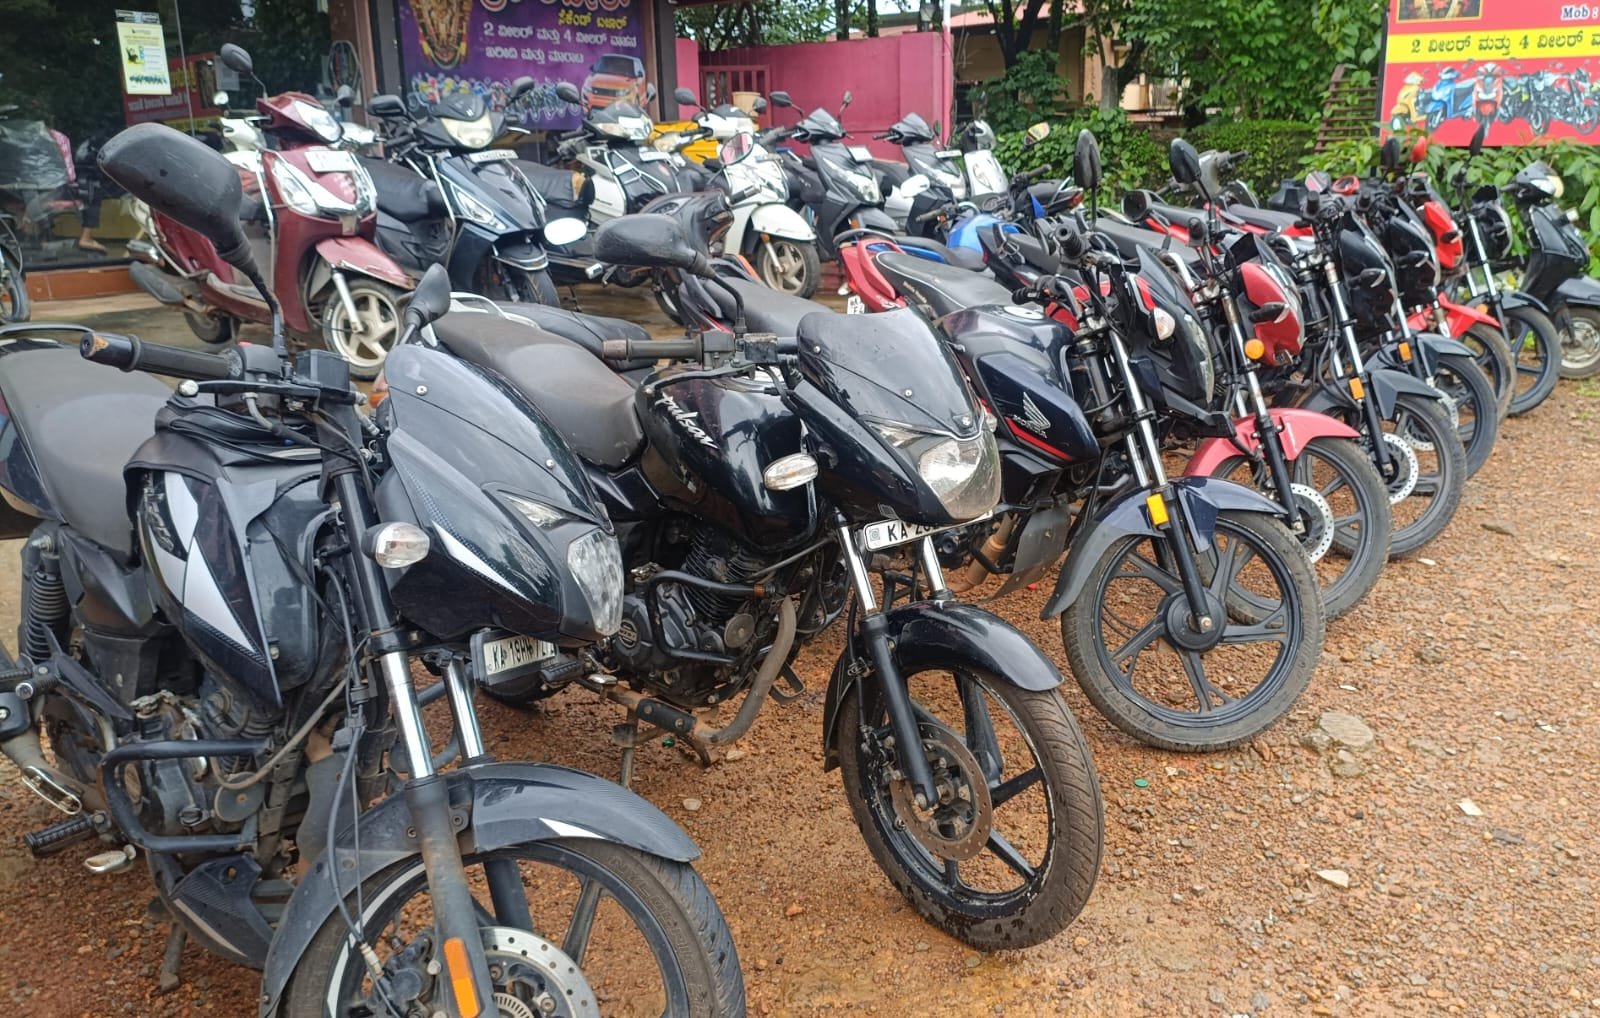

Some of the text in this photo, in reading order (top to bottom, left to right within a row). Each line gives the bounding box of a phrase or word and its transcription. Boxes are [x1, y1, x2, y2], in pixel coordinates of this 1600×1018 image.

[1561, 6, 1589, 19] Mob
[483, 21, 494, 36] 2
[497, 24, 533, 39] ವೀಲರ್
[536, 27, 560, 44] ಮತ್ತು
[563, 29, 572, 43] 4
[575, 31, 607, 45] ವೀಲರ್
[1411, 39, 1421, 53] 2
[1428, 35, 1471, 53] ವೀಲರ್
[1478, 35, 1511, 56] ಮತ್ತು
[1519, 35, 1529, 49] 4
[1537, 30, 1583, 49] ವೀಲರ್
[520, 47, 545, 64] ಮತ್ತು
[887, 523, 909, 542] KA
